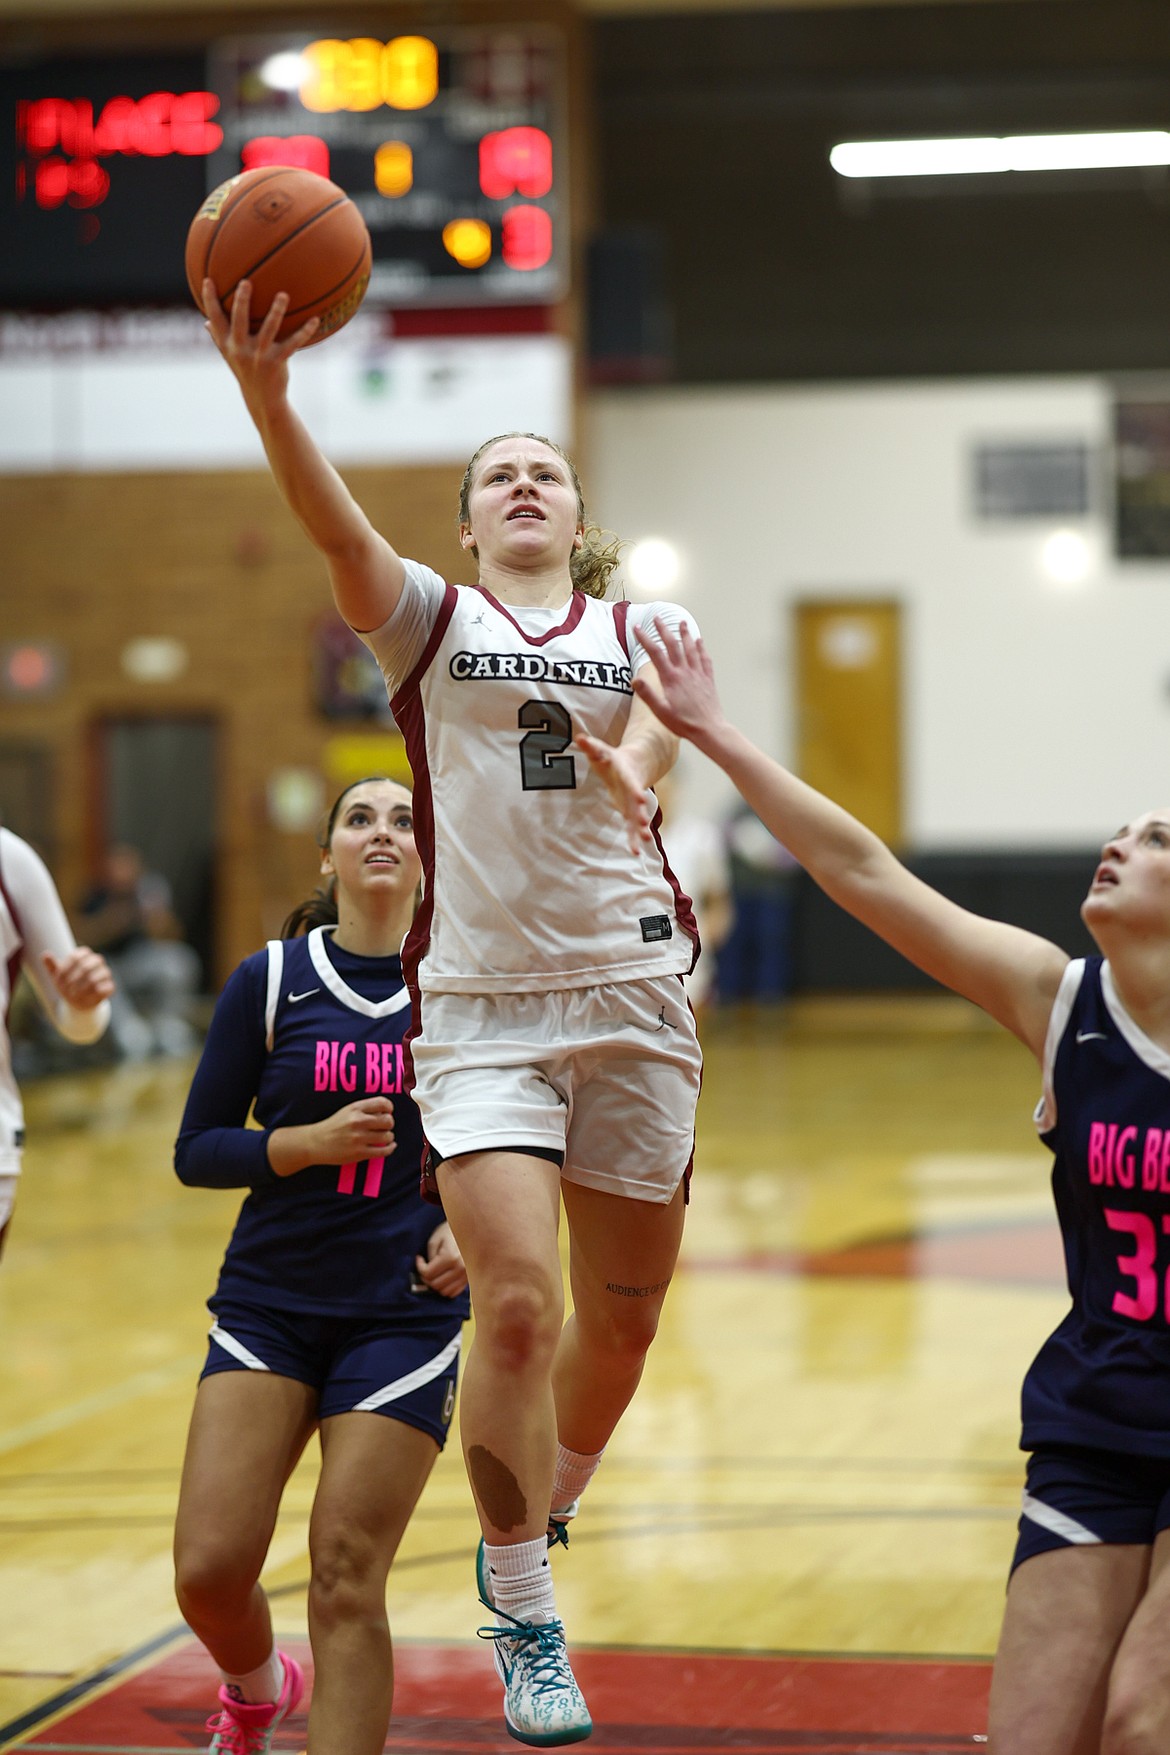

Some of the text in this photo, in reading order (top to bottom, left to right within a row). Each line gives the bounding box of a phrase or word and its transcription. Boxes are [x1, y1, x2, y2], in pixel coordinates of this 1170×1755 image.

[449, 651, 633, 695] CARDINALS
[518, 699, 576, 791] 2
[314, 1041, 357, 1092] BIG
[1089, 1122, 1138, 1188] BIG
[606, 1283, 650, 1297] AUDIENCE
[1103, 1207, 1170, 1325] 3
